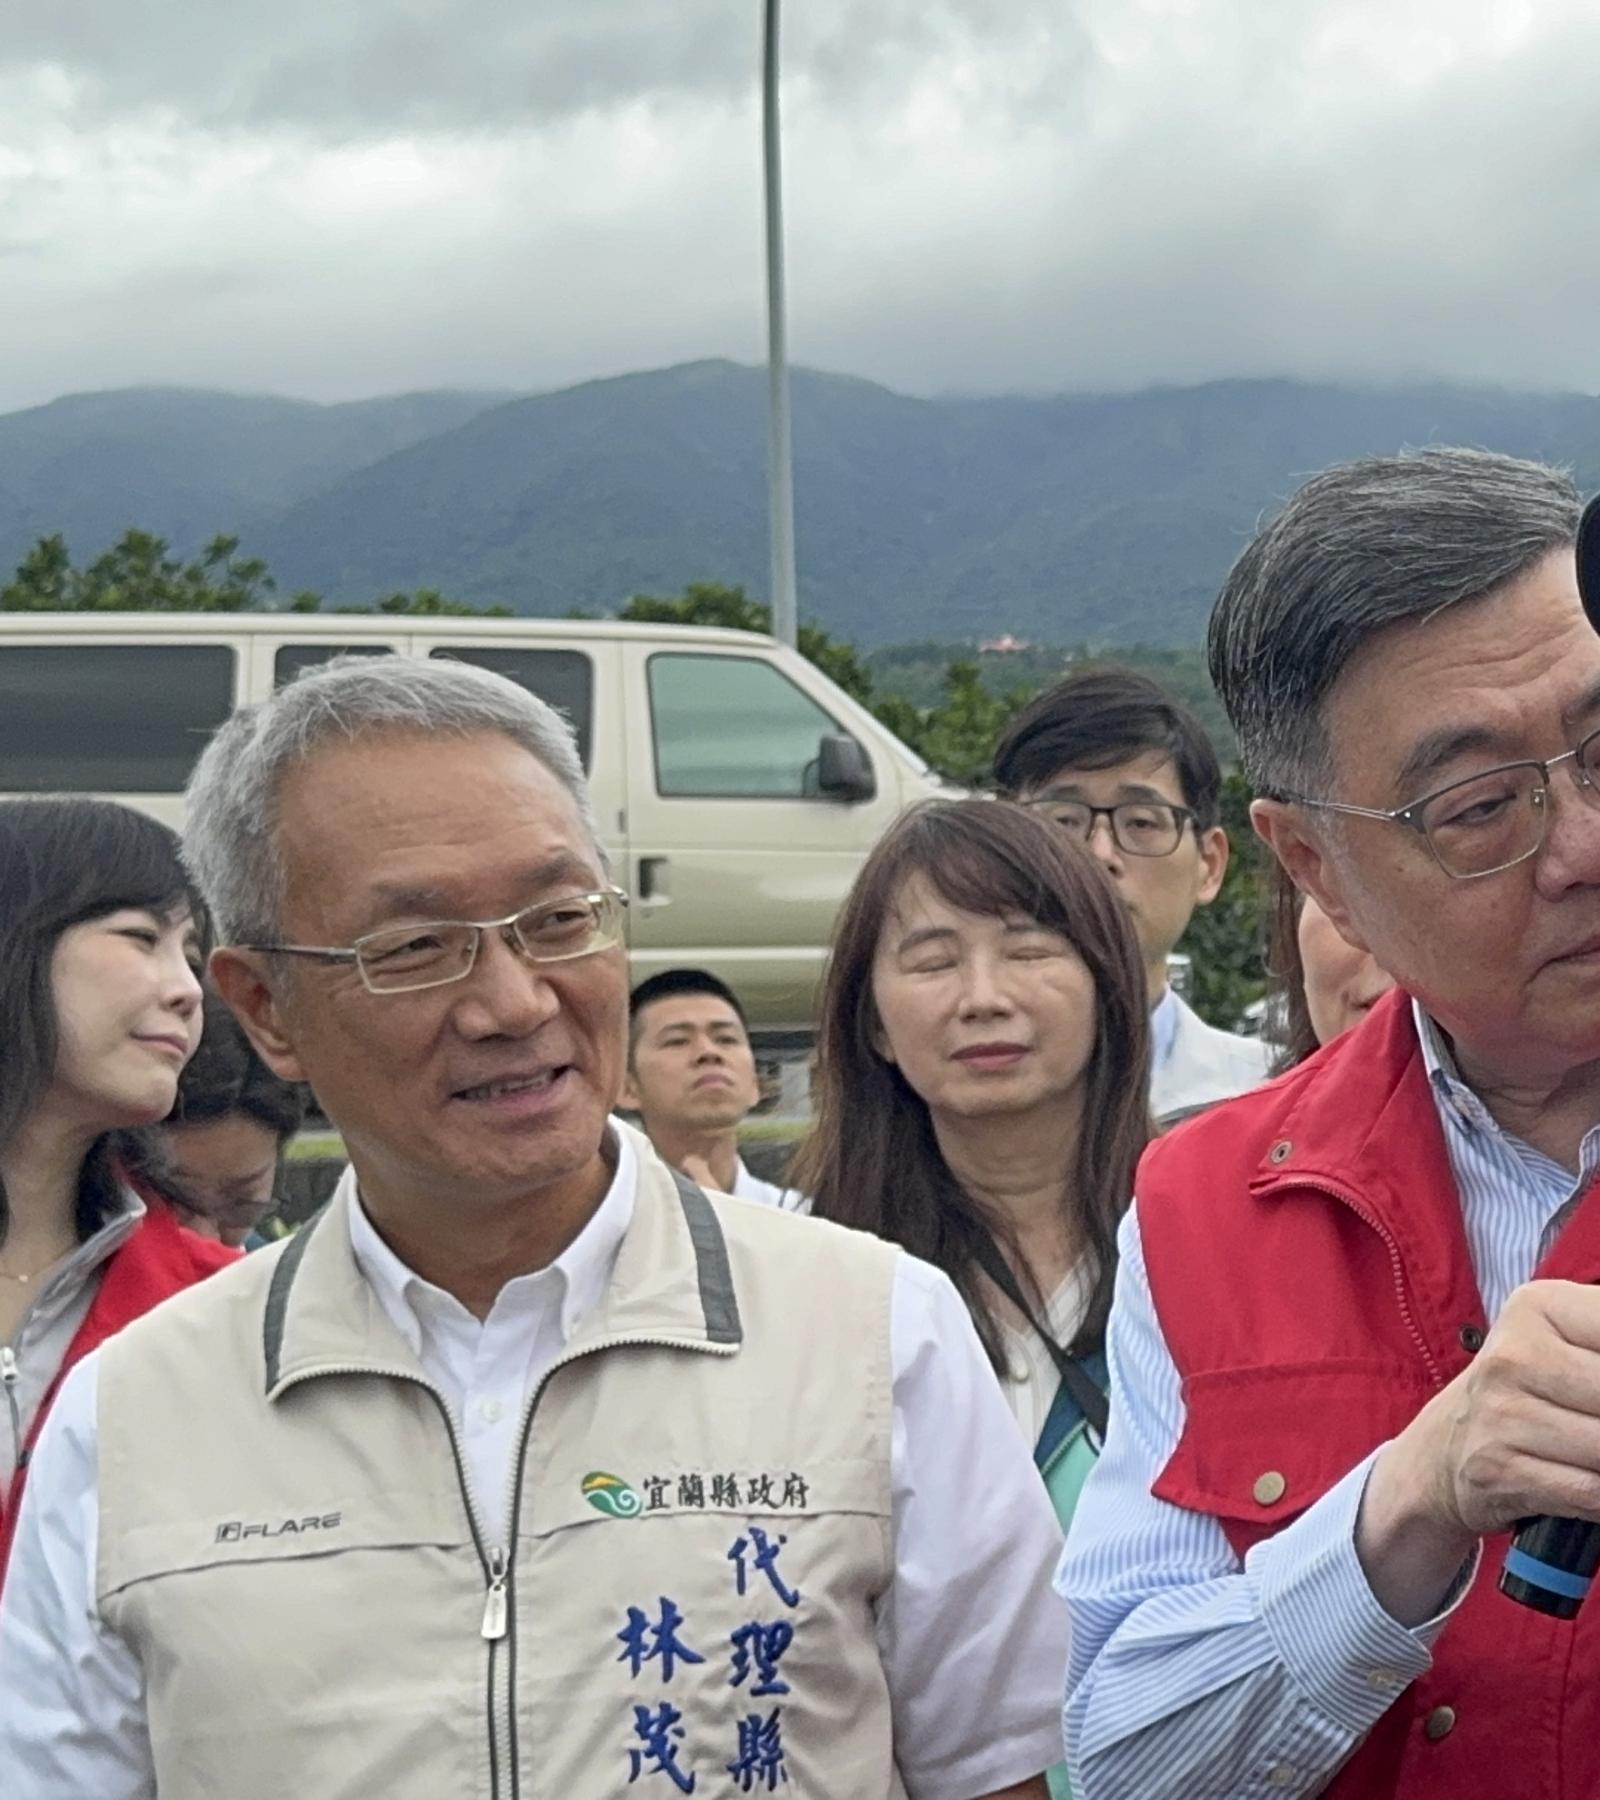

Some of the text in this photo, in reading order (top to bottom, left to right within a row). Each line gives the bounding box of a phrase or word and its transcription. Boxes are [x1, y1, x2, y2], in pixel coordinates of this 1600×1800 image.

[242, 1511, 342, 1539] FLARE
[642, 1472, 809, 1510] 宜蘭縣政府
[617, 1596, 706, 1794] 林茂
[726, 1527, 799, 1792] 代理縣
